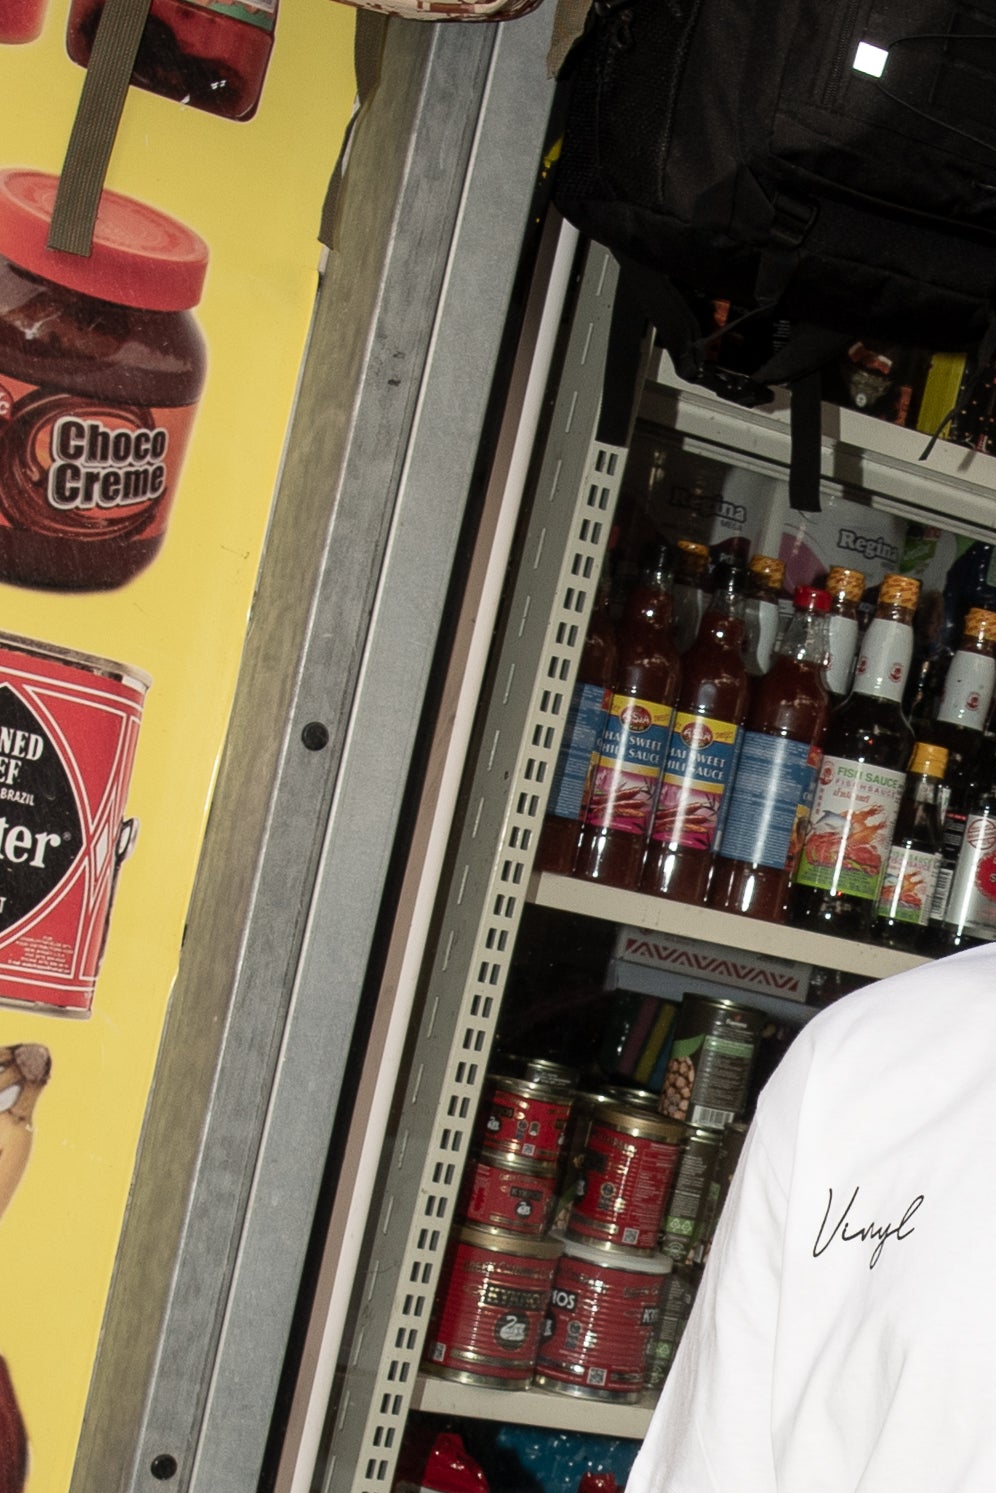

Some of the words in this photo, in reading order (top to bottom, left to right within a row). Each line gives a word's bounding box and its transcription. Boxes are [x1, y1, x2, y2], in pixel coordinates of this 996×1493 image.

[53, 416, 169, 467] Choco
[49, 463, 166, 509] Creme
[0, 726, 44, 761] NED
[865, 772, 899, 790] SAUCE
[812, 1185, 925, 1271] Vinyl
